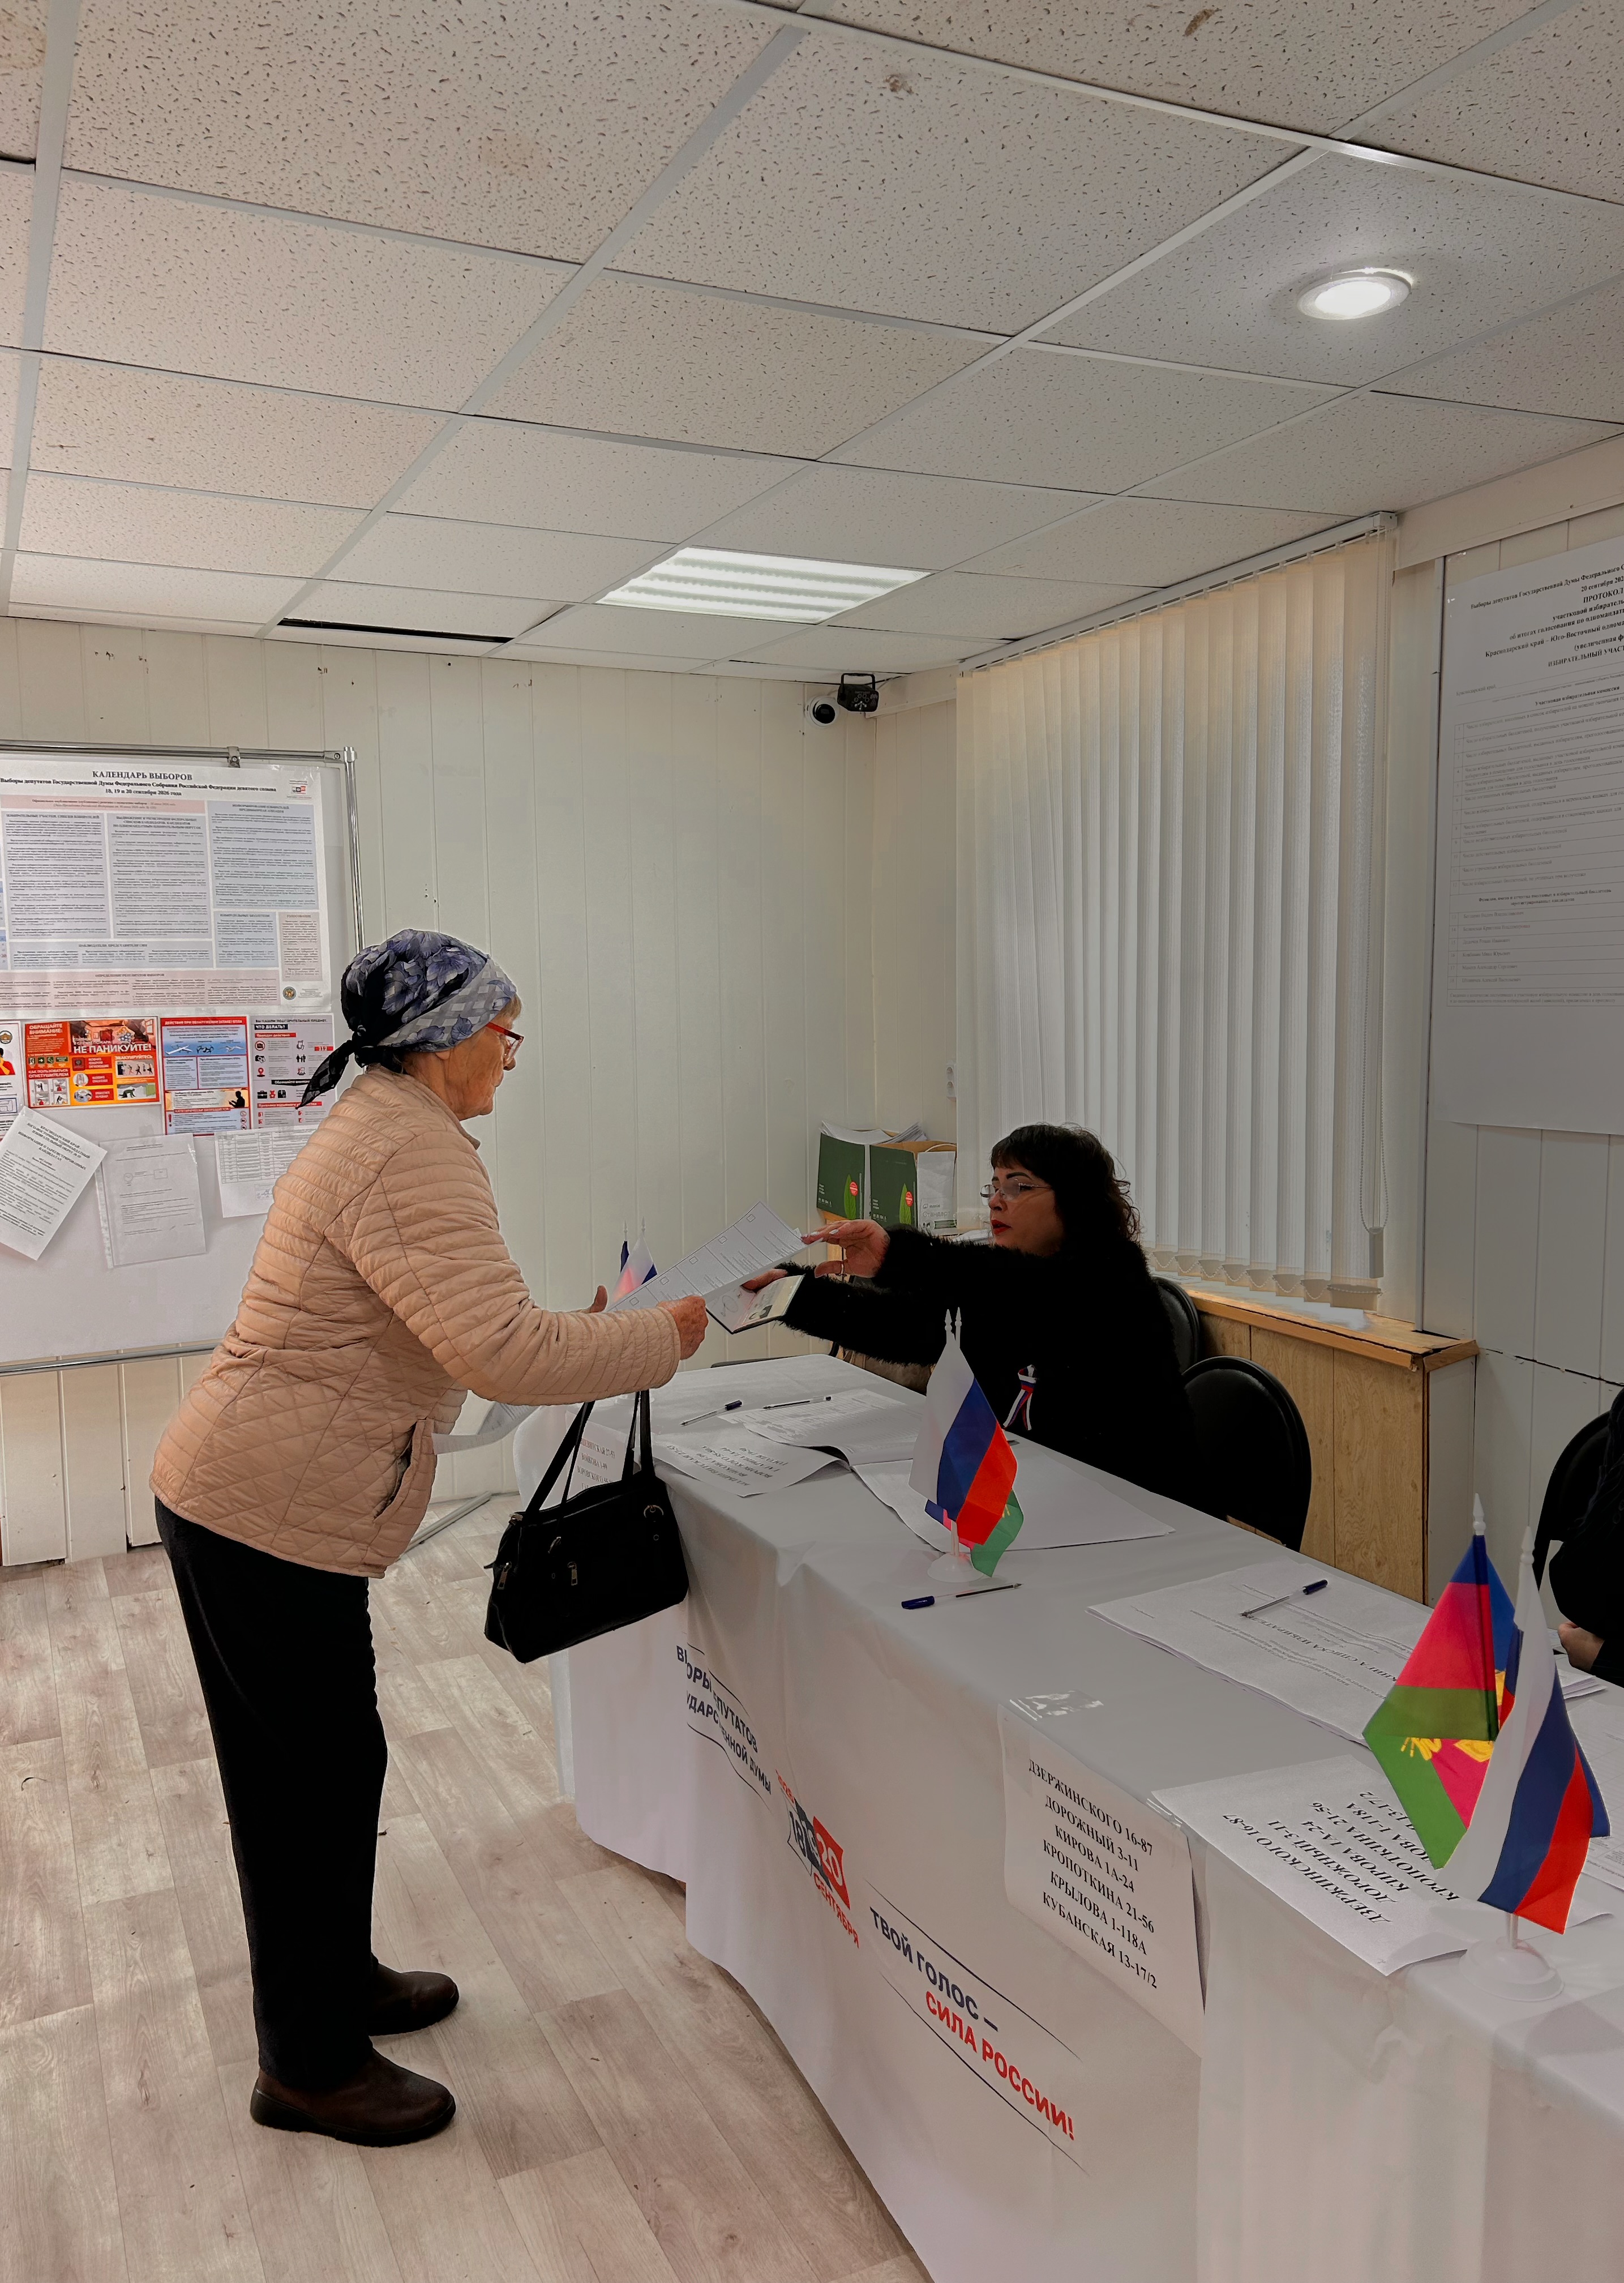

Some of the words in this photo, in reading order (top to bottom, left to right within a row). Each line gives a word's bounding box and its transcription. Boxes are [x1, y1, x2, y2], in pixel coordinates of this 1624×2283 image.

[1537, 619, 1575, 634] голосования
[1552, 607, 1588, 622] участковой
[1485, 642, 1528, 657] Краснодарский
[1530, 638, 1544, 648] край
[1550, 625, 1601, 642] Юго-Восточный
[1548, 648, 1602, 667] ИЗБИРАТЕЛЬНЫЙ
[92, 771, 147, 780] КАЛЕНДАРЬ
[149, 772, 193, 781] ВЫБОРОВ
[89, 1042, 152, 1054] ПАНИКУЙТЕ!
[1245, 1615, 1313, 1644] ИЗБИРАТЕЛ
[1313, 1644, 1359, 1662] СПИСКА
[713, 1690, 757, 1753] ПУТАТОВ
[749, 1755, 771, 1795] ДУМЫ
[1029, 1758, 1122, 1835] ДЗЕРЖИНСКОГО
[1125, 1827, 1153, 1857] 16-87
[1222, 1814, 1261, 1836] 16-87
[1267, 1819, 1300, 1839] 3-11
[1311, 1801, 1348, 1825] 21-56
[1346, 1802, 1387, 1833] 1-118А
[1045, 1794, 1115, 1852] ДОРОЖНЫЙ
[1117, 1846, 1139, 1871] 3-11
[1300, 1820, 1343, 1846] 1А-24
[1392, 1833, 1432, 1862] ЛОВА
[816, 1832, 843, 1887] 20
[1055, 1824, 1103, 1870] КИРОВА
[1105, 1861, 1135, 1893] 1А-24
[1256, 1837, 1393, 1923] ДЗЕРЖИНСКОГО
[1292, 1839, 1398, 1904] ДОРОЖНЫЙ
[1342, 1846, 1411, 1892] КИРОВА
[1346, 1825, 1460, 1902] КРОПОТКИНА
[1043, 1839, 1124, 1911] КРОПОТКИНА
[1126, 1901, 1155, 1934] 21-56
[813, 1872, 859, 1949] СЕНТЯБРЯ
[1051, 1871, 1108, 1925] КРЫЛОВА
[1111, 1917, 1147, 1956] 1-118А
[1043, 1891, 1116, 1957] КУБАНСКАЯ
[1119, 1949, 1157, 1989] 13-17/2
[869, 1906, 914, 1964] ТВОЙ
[916, 1951, 979, 2020] ГОЛОС
[925, 1990, 978, 2054] СИЛА
[982, 2038, 1074, 2140] РОССИИ!
